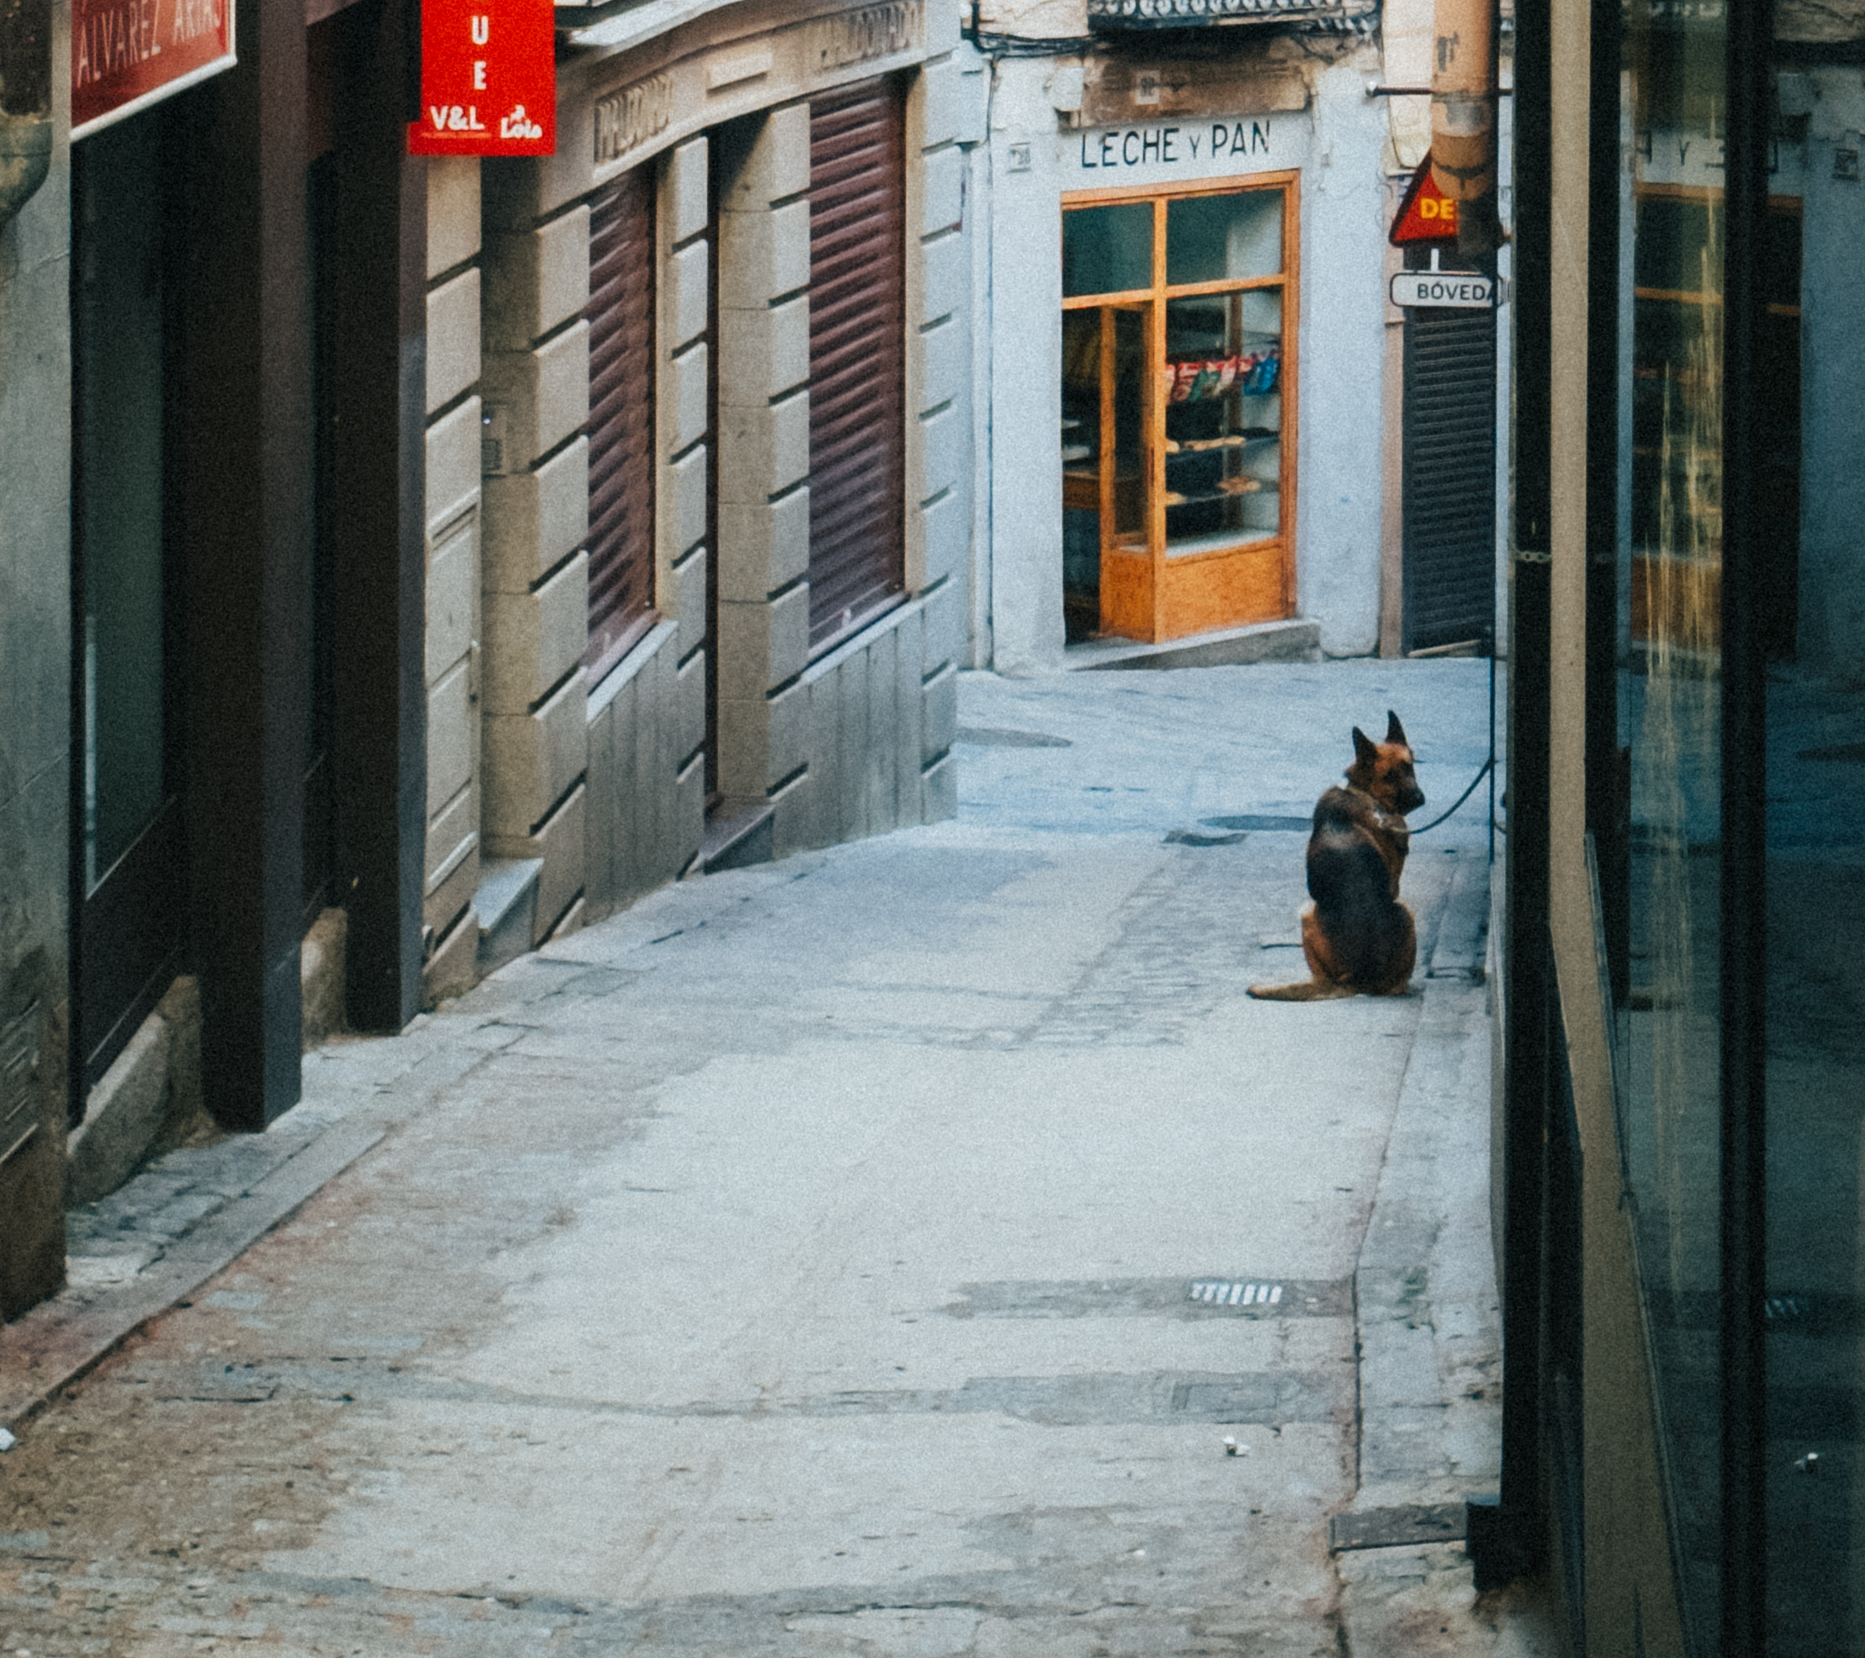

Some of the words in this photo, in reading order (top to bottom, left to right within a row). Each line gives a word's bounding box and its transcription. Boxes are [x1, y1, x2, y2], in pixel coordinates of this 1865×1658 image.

[430, 106, 485, 131] V&L
[1081, 127, 1180, 168] LECHE
[1212, 120, 1271, 158] PAN
